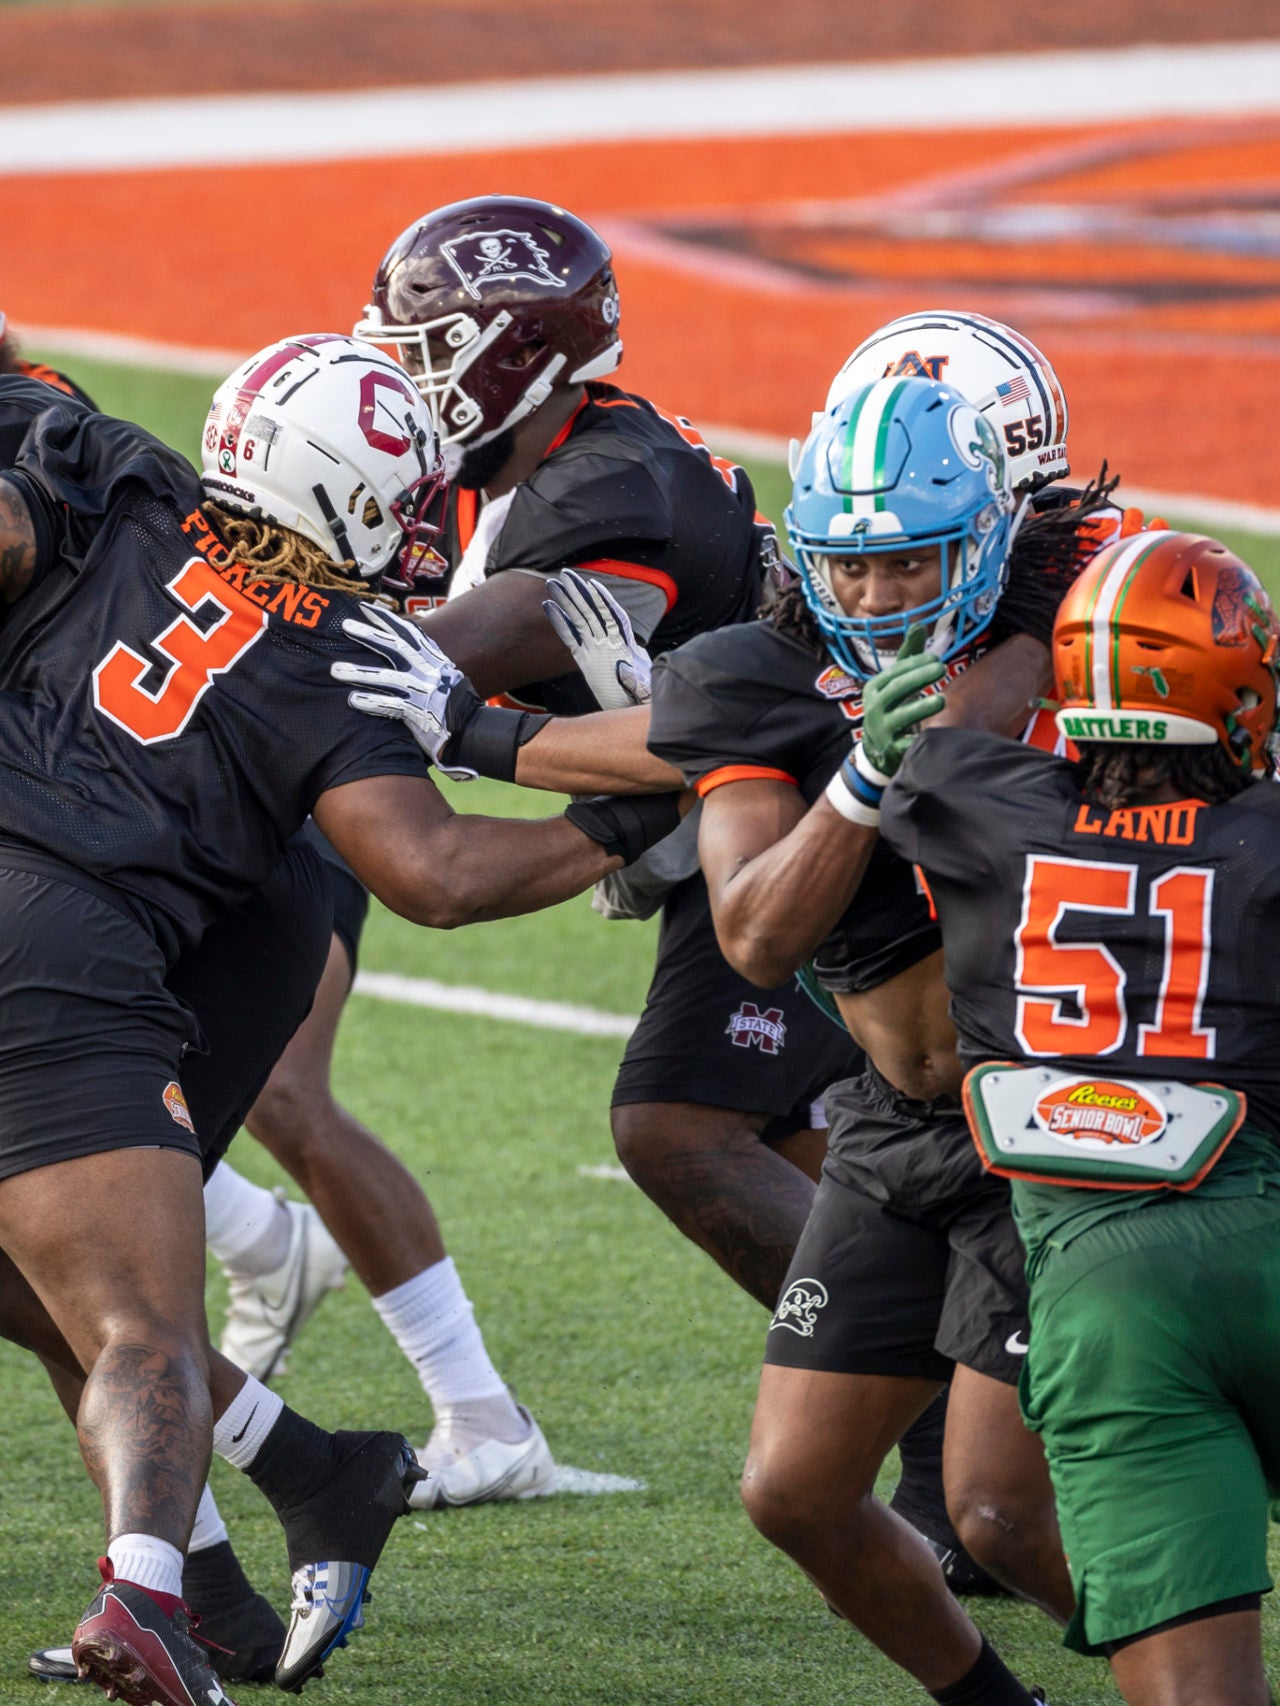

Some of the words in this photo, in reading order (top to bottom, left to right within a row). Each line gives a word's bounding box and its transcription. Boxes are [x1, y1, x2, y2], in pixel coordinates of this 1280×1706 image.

[243, 438, 256, 462] 6
[1003, 414, 1044, 458] 55
[1037, 449, 1057, 466] WAR
[92, 556, 270, 746] 3
[1073, 804, 1197, 846] LAND
[1014, 854, 1215, 1060] 51
[738, 1018, 776, 1037] STATE
[1067, 1085, 1138, 1111] Reese's
[1049, 1106, 1107, 1133] SENIOR
[1103, 1111, 1143, 1143] BOWL
